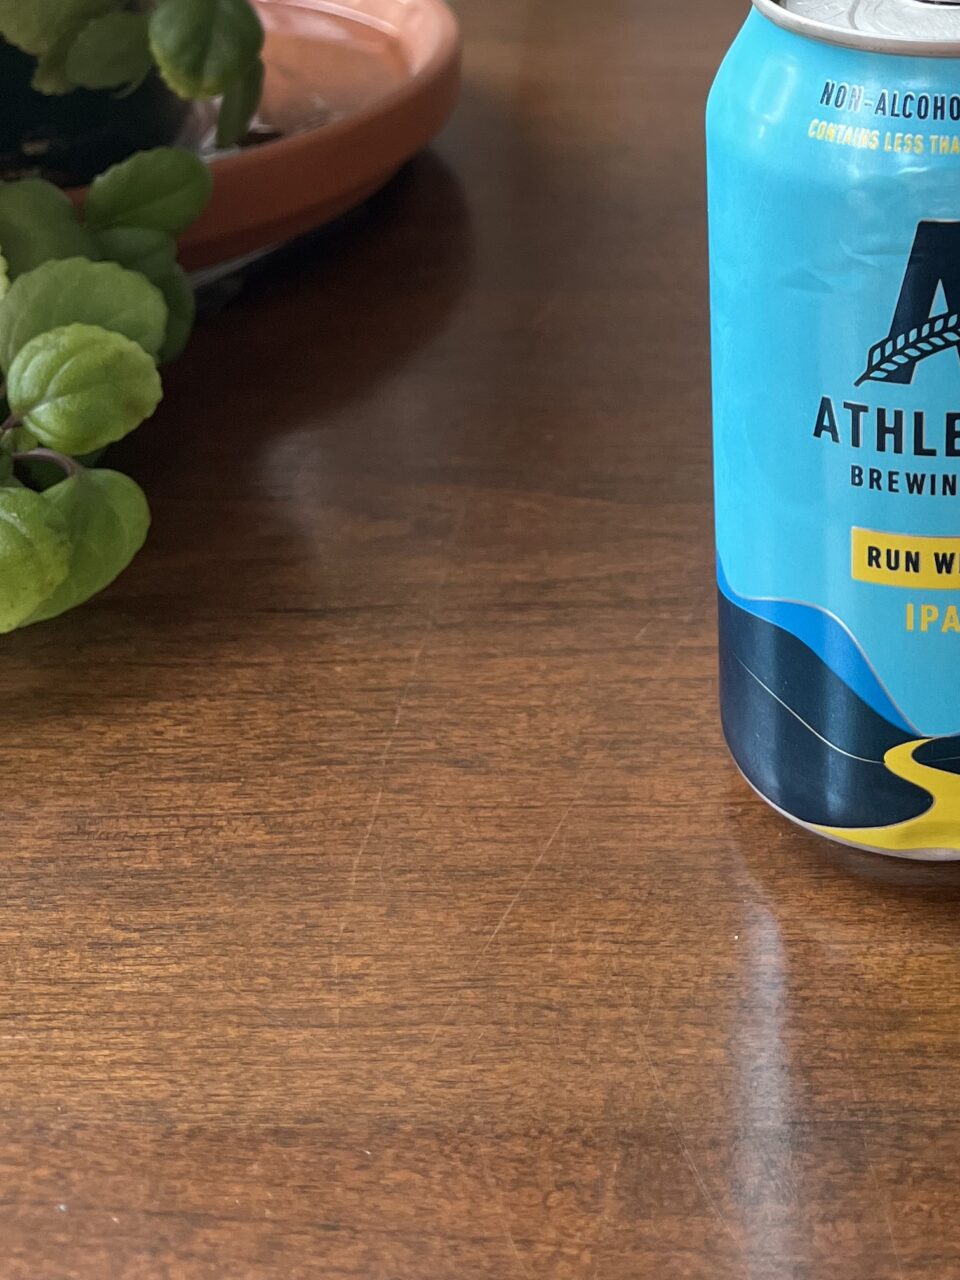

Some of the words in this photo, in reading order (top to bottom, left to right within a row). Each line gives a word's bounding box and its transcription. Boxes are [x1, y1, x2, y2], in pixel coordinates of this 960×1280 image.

[808, 118, 880, 150] CONTAINS
[885, 129, 924, 154] LESS
[867, 546, 921, 573] RUN
